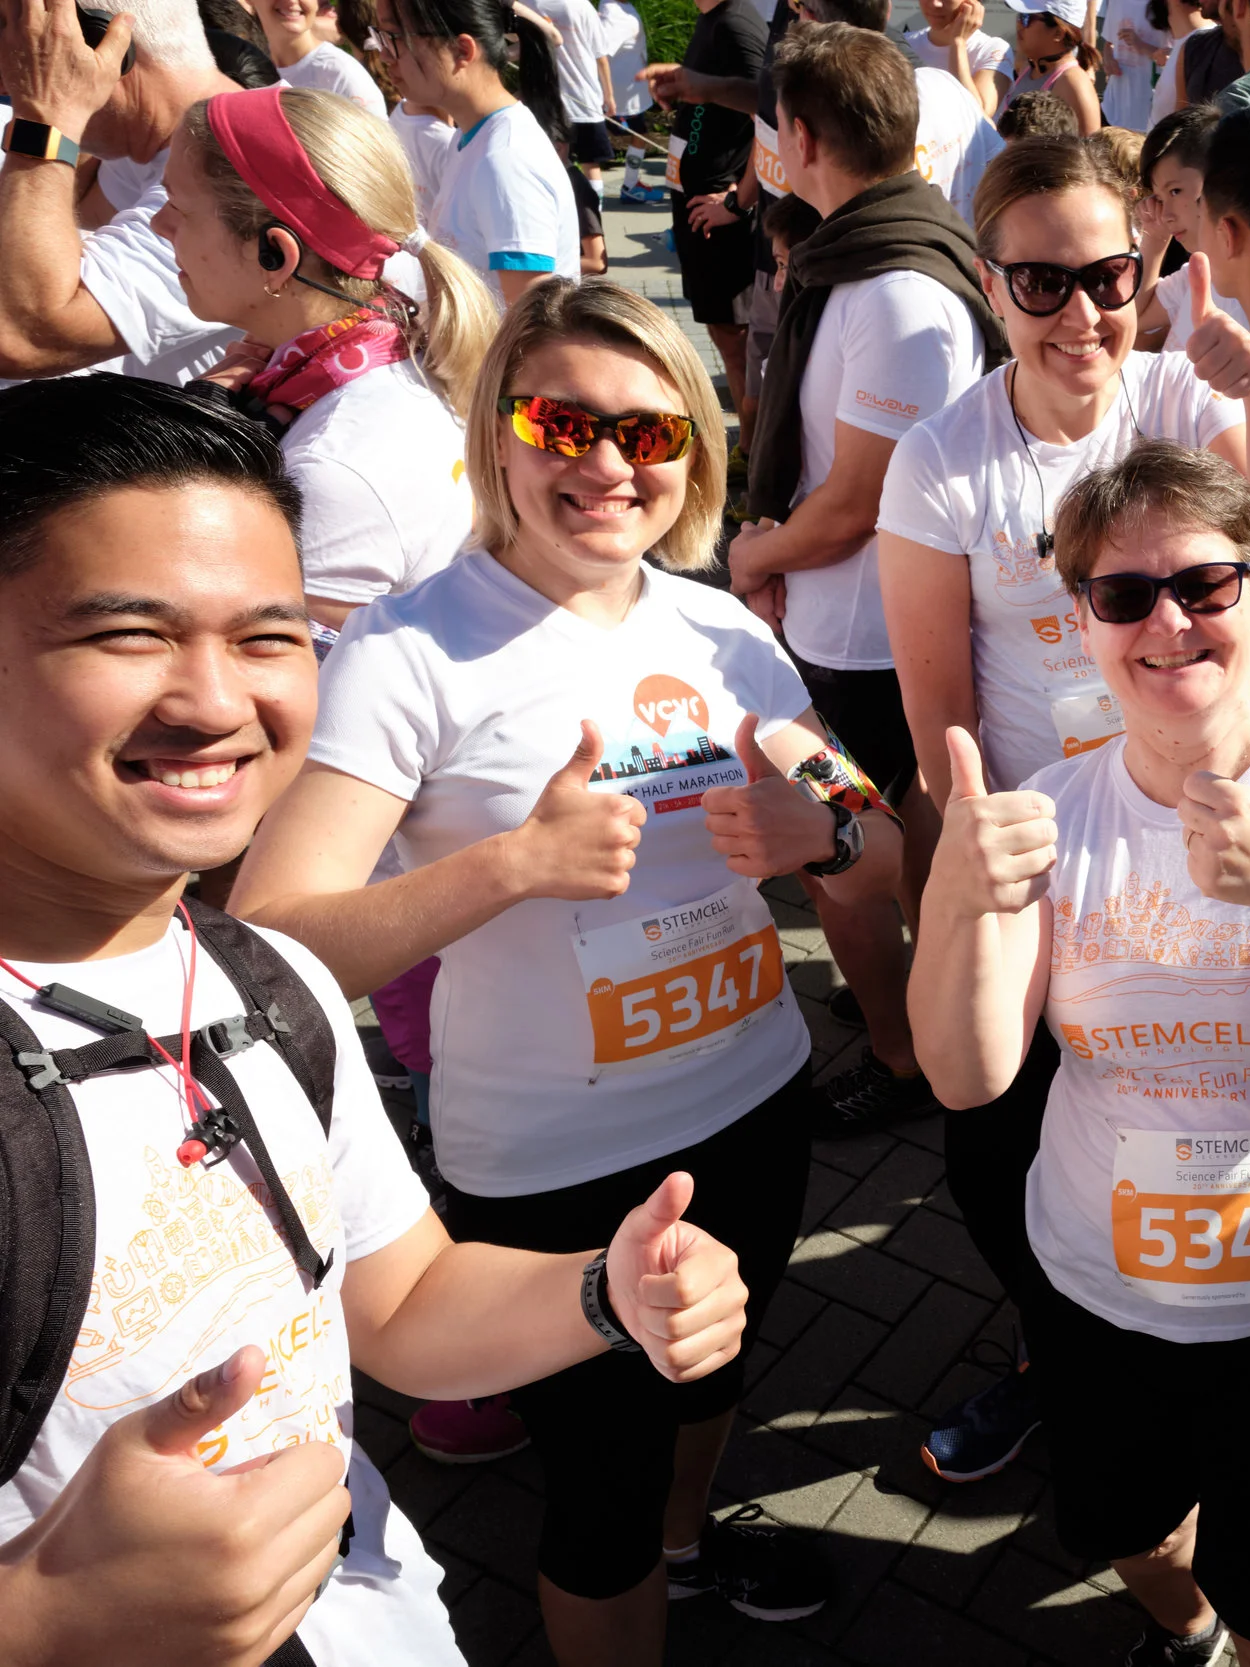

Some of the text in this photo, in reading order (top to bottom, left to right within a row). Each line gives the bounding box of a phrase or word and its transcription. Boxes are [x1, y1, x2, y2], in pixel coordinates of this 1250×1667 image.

[1043, 655, 1097, 672] Scienc
[641, 782, 675, 798] HALF
[679, 768, 743, 791] MARATHON
[662, 898, 729, 931] STEMCELL
[650, 923, 736, 961] Science Fair Fun Run
[621, 943, 764, 1048] 5347
[1116, 1083, 1248, 1102] 20TH ANNIVERSARY
[1199, 1071, 1238, 1090] Fun
[1176, 1170, 1216, 1182] Science
[1218, 1170, 1238, 1181] Fair
